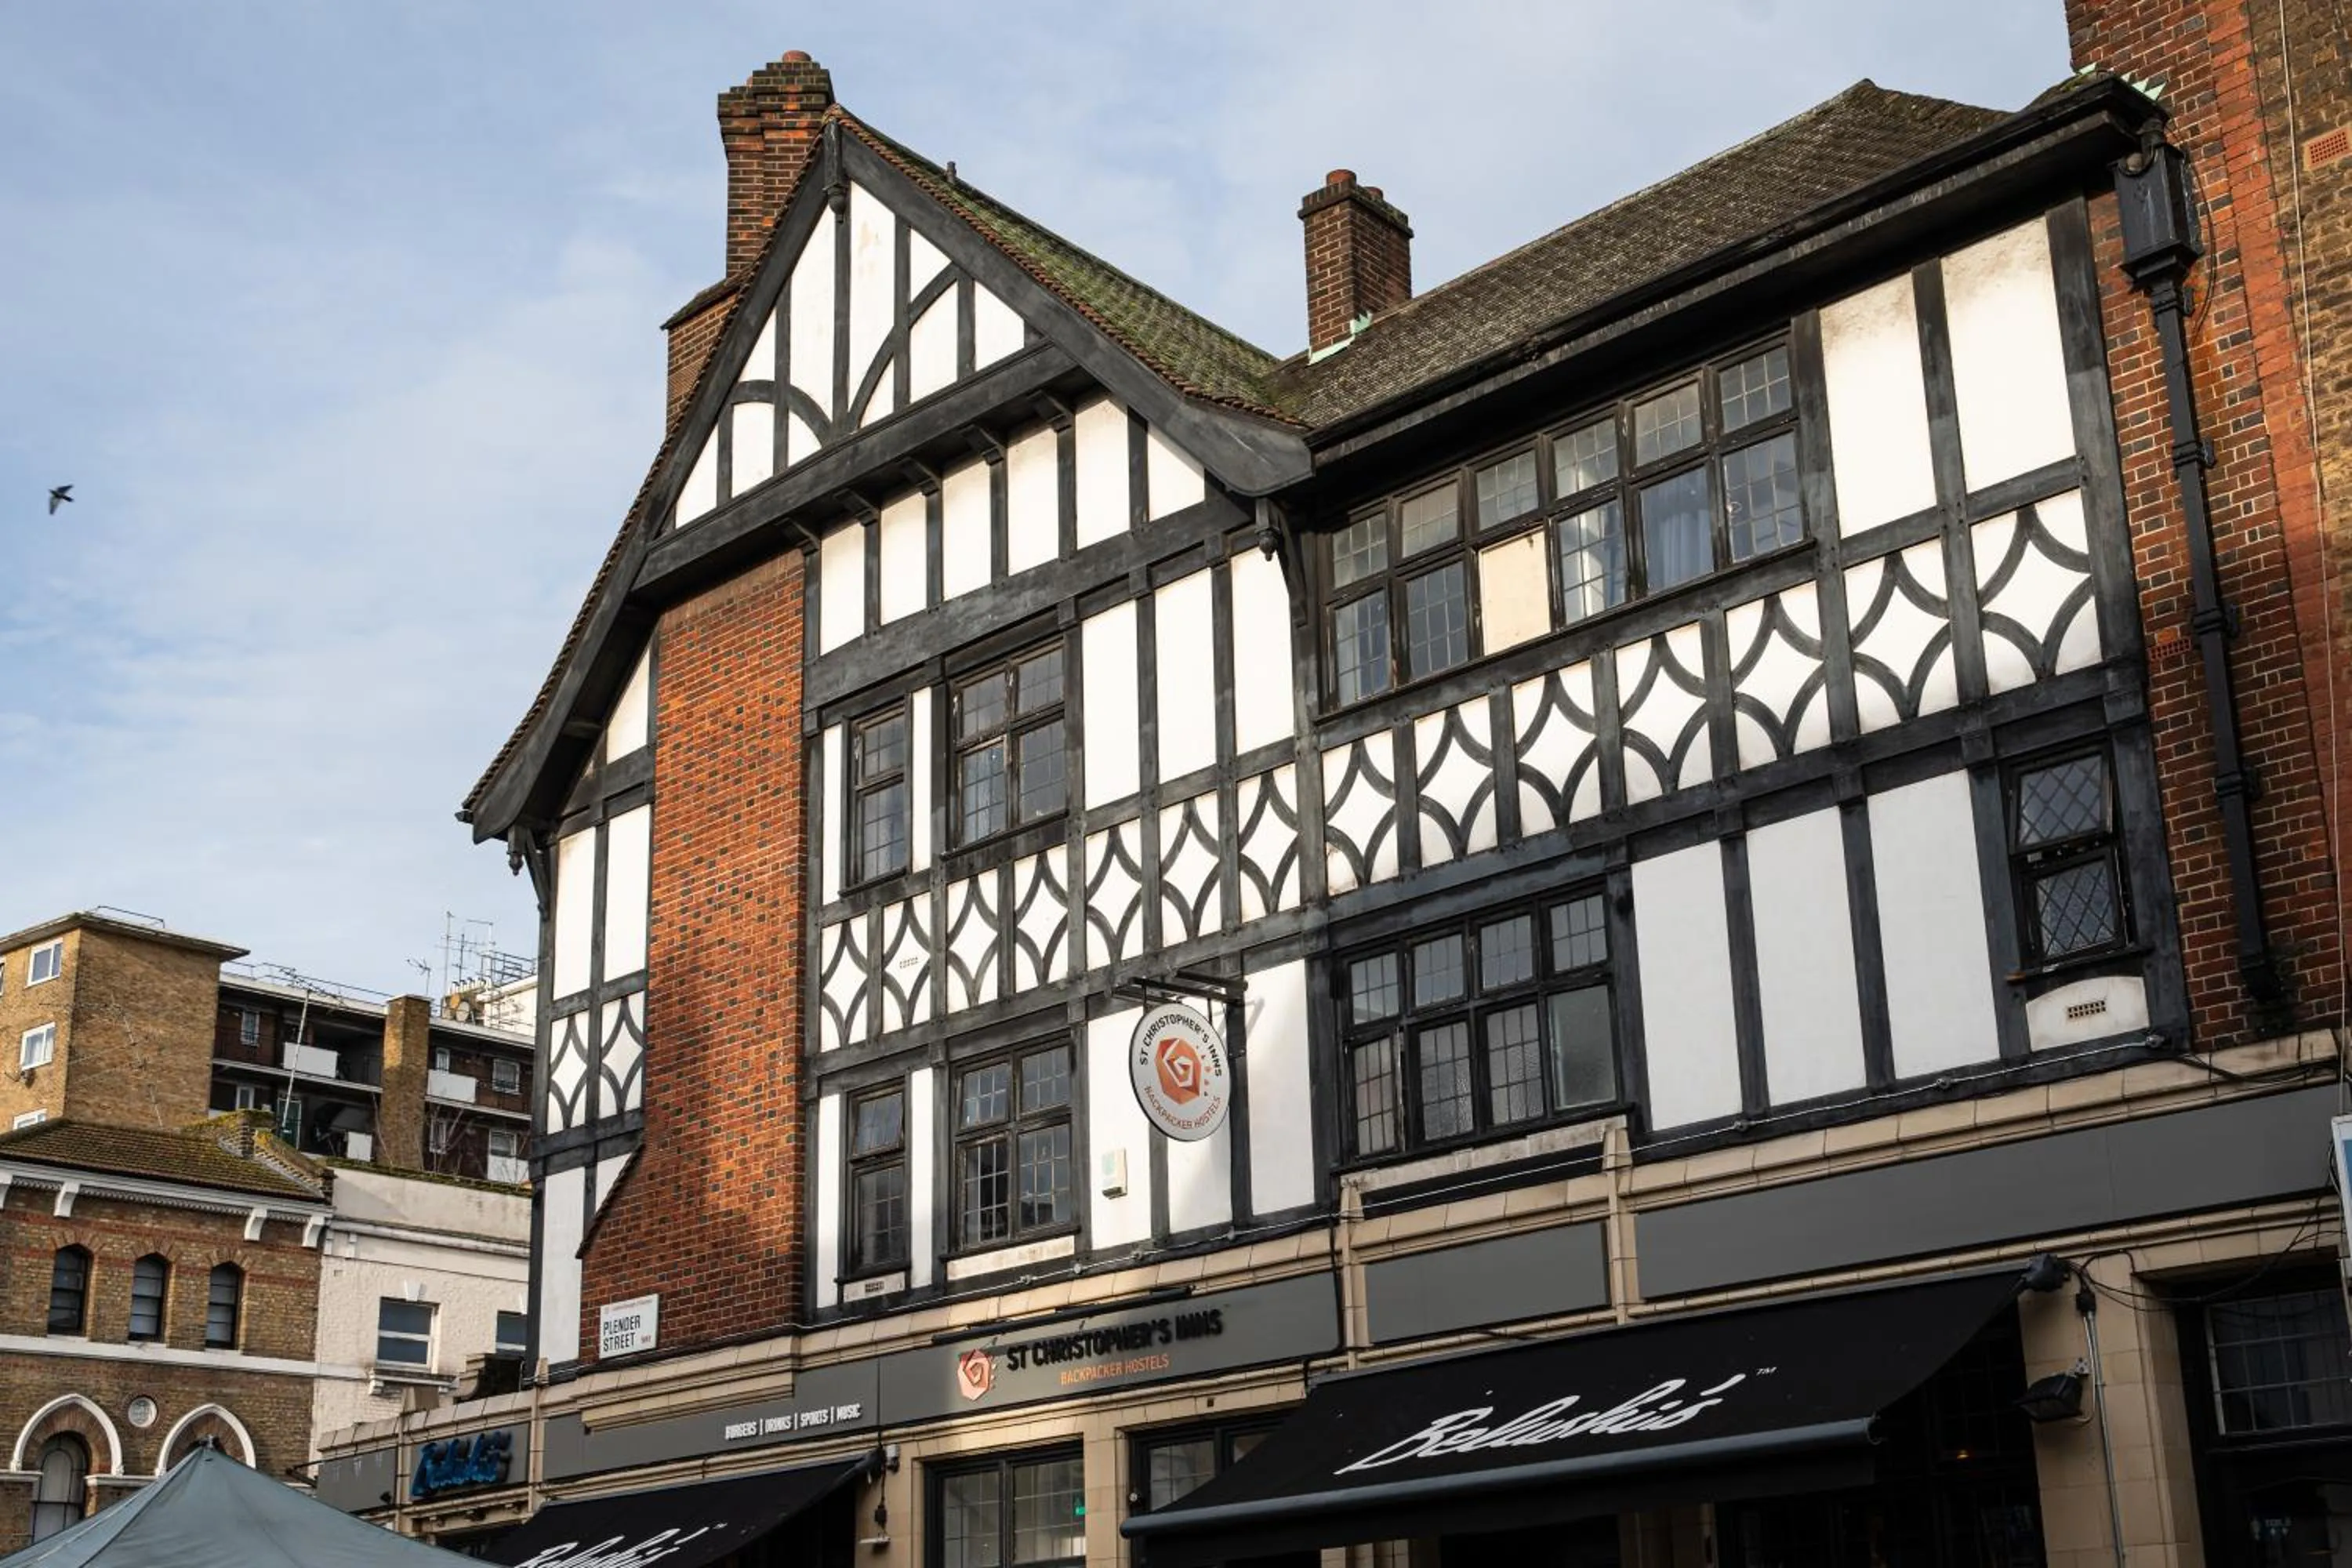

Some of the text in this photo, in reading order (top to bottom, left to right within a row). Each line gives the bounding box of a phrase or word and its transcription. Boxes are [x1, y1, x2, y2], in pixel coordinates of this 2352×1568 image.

[1139, 1014, 1222, 1077] ST CHRISTOPHER'S INNS
[1144, 1085, 1221, 1129] BACKPACKER HOSTELS
[603, 1315, 641, 1336] PLENDER
[1007, 1309, 1222, 1371] ST CHRISTOPHER'S INNS
[603, 1333, 636, 1352] STREET
[1060, 1353, 1170, 1386] BACKPACKER HOSTELS
[800, 1408, 829, 1428] SPORTS
[837, 1403, 862, 1421] MUSIC
